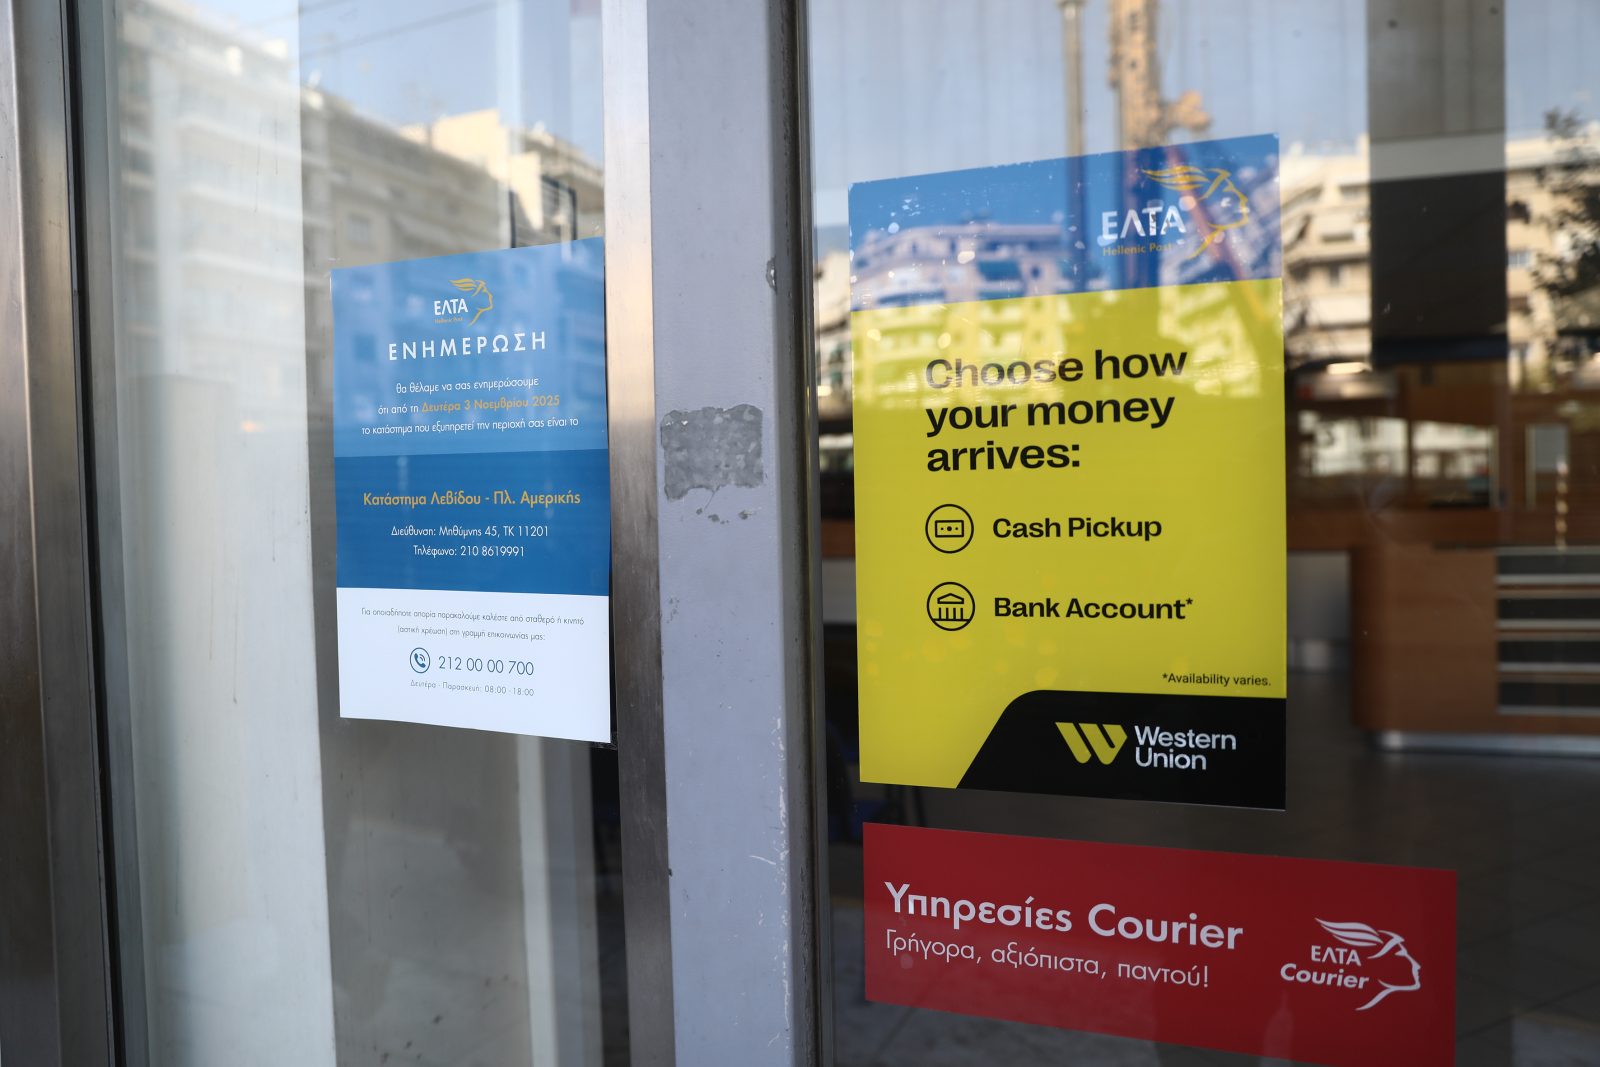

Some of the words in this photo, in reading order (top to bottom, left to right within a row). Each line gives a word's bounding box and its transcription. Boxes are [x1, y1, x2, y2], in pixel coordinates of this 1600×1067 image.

[1101, 205, 1187, 240] ΕΛΤΑ
[1103, 245, 1146, 257] Hellenic
[433, 298, 468, 316] ΕΛΤΑ
[388, 331, 546, 361] ΕΝΗΜΕΡΩΣΗ
[925, 355, 1083, 389] Choose
[1095, 349, 1187, 380] how
[409, 381, 439, 395] θέλαμε
[442, 383, 452, 391] να
[455, 380, 471, 390] σας
[473, 377, 539, 392] ενημερώσουμε
[378, 405, 389, 415] ότι
[391, 403, 408, 415] από
[409, 405, 419, 413] τη
[422, 400, 461, 414] Δευτέρα
[464, 400, 471, 410] 3
[474, 397, 529, 411] Νοεμβρίου
[531, 395, 560, 407] 2025
[362, 427, 371, 435] το
[372, 423, 413, 436] κατάστημα
[415, 424, 430, 434] που
[432, 420, 475, 434] εξυπηρετεί
[476, 422, 490, 431] την
[492, 418, 525, 431] περιοχή
[528, 419, 544, 428] σας
[547, 416, 567, 427] είναι
[569, 418, 579, 426] το
[925, 403, 1017, 438] your
[1027, 396, 1175, 429] money
[927, 440, 1080, 472] arrives:
[363, 492, 426, 508] Κατάστημα
[430, 491, 481, 505] Λεβίδου
[493, 490, 515, 504] Πλ.
[520, 490, 581, 508] Αμερικής
[391, 525, 436, 538] Διεύθυνση:
[439, 525, 482, 539] Μηθύμνης
[485, 526, 500, 538] 45,
[503, 526, 515, 536] ΤΚ
[518, 526, 548, 537] 11201
[992, 517, 1061, 538] Cash
[1068, 516, 1162, 542] Pickup
[413, 544, 457, 558] Τηλέφωνο:
[460, 546, 479, 556] 210
[481, 546, 525, 557] 8619991
[361, 608, 371, 616] Για
[437, 610, 480, 621] παρακαλούμε
[482, 611, 508, 622] καλέστε
[510, 613, 524, 624] από
[525, 612, 555, 625] σταθερό
[564, 617, 585, 626] κινητό
[994, 597, 1060, 618] Bank
[449, 628, 460, 636] στη
[462, 628, 486, 639] γραμμή
[487, 628, 529, 640] επικοινωνίας
[530, 632, 545, 642] μας:
[438, 655, 462, 671] 212
[466, 657, 483, 672] 00
[487, 658, 504, 674] 00
[508, 660, 534, 676] 700
[410, 680, 436, 690] Δευτέρα
[442, 682, 482, 692] Παρασκευή:
[485, 684, 507, 695] 08:00
[513, 687, 535, 697] 18:00
[1233, 675, 1272, 687] varies.
[1134, 725, 1237, 750] Western
[1135, 746, 1207, 770] Union
[884, 881, 1073, 933] Υπηρεσίες
[1088, 903, 1244, 950] Courier
[886, 928, 982, 965] Γρήγορα,
[991, 942, 1107, 979] αξιόπιστα,
[1118, 962, 1209, 988] παντού!
[1311, 945, 1362, 967] ΕΛΤΑ
[1280, 963, 1369, 990] Courier
